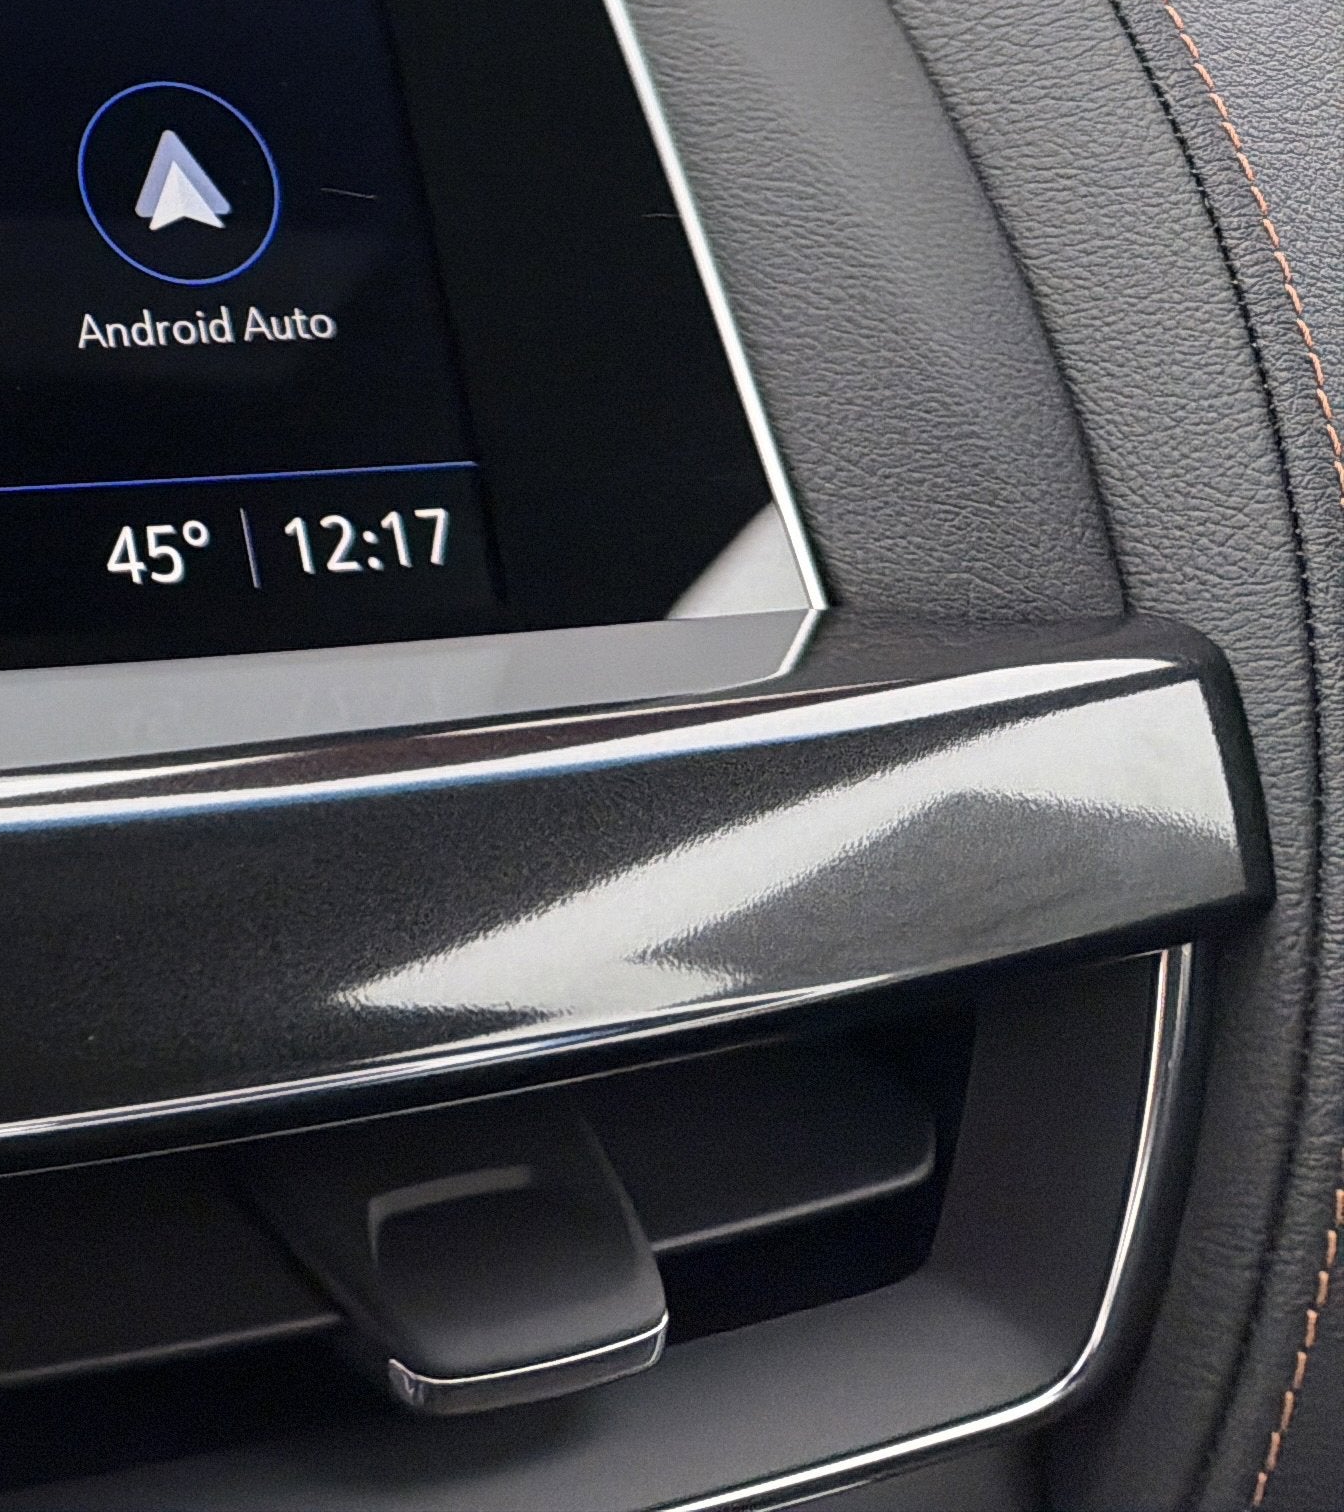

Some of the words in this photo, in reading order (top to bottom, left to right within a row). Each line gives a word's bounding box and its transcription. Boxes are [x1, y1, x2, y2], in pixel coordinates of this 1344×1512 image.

[78, 305, 234, 351] Android
[243, 307, 338, 342] Auto
[107, 519, 210, 586] 45°
[285, 507, 450, 577] 12:17
